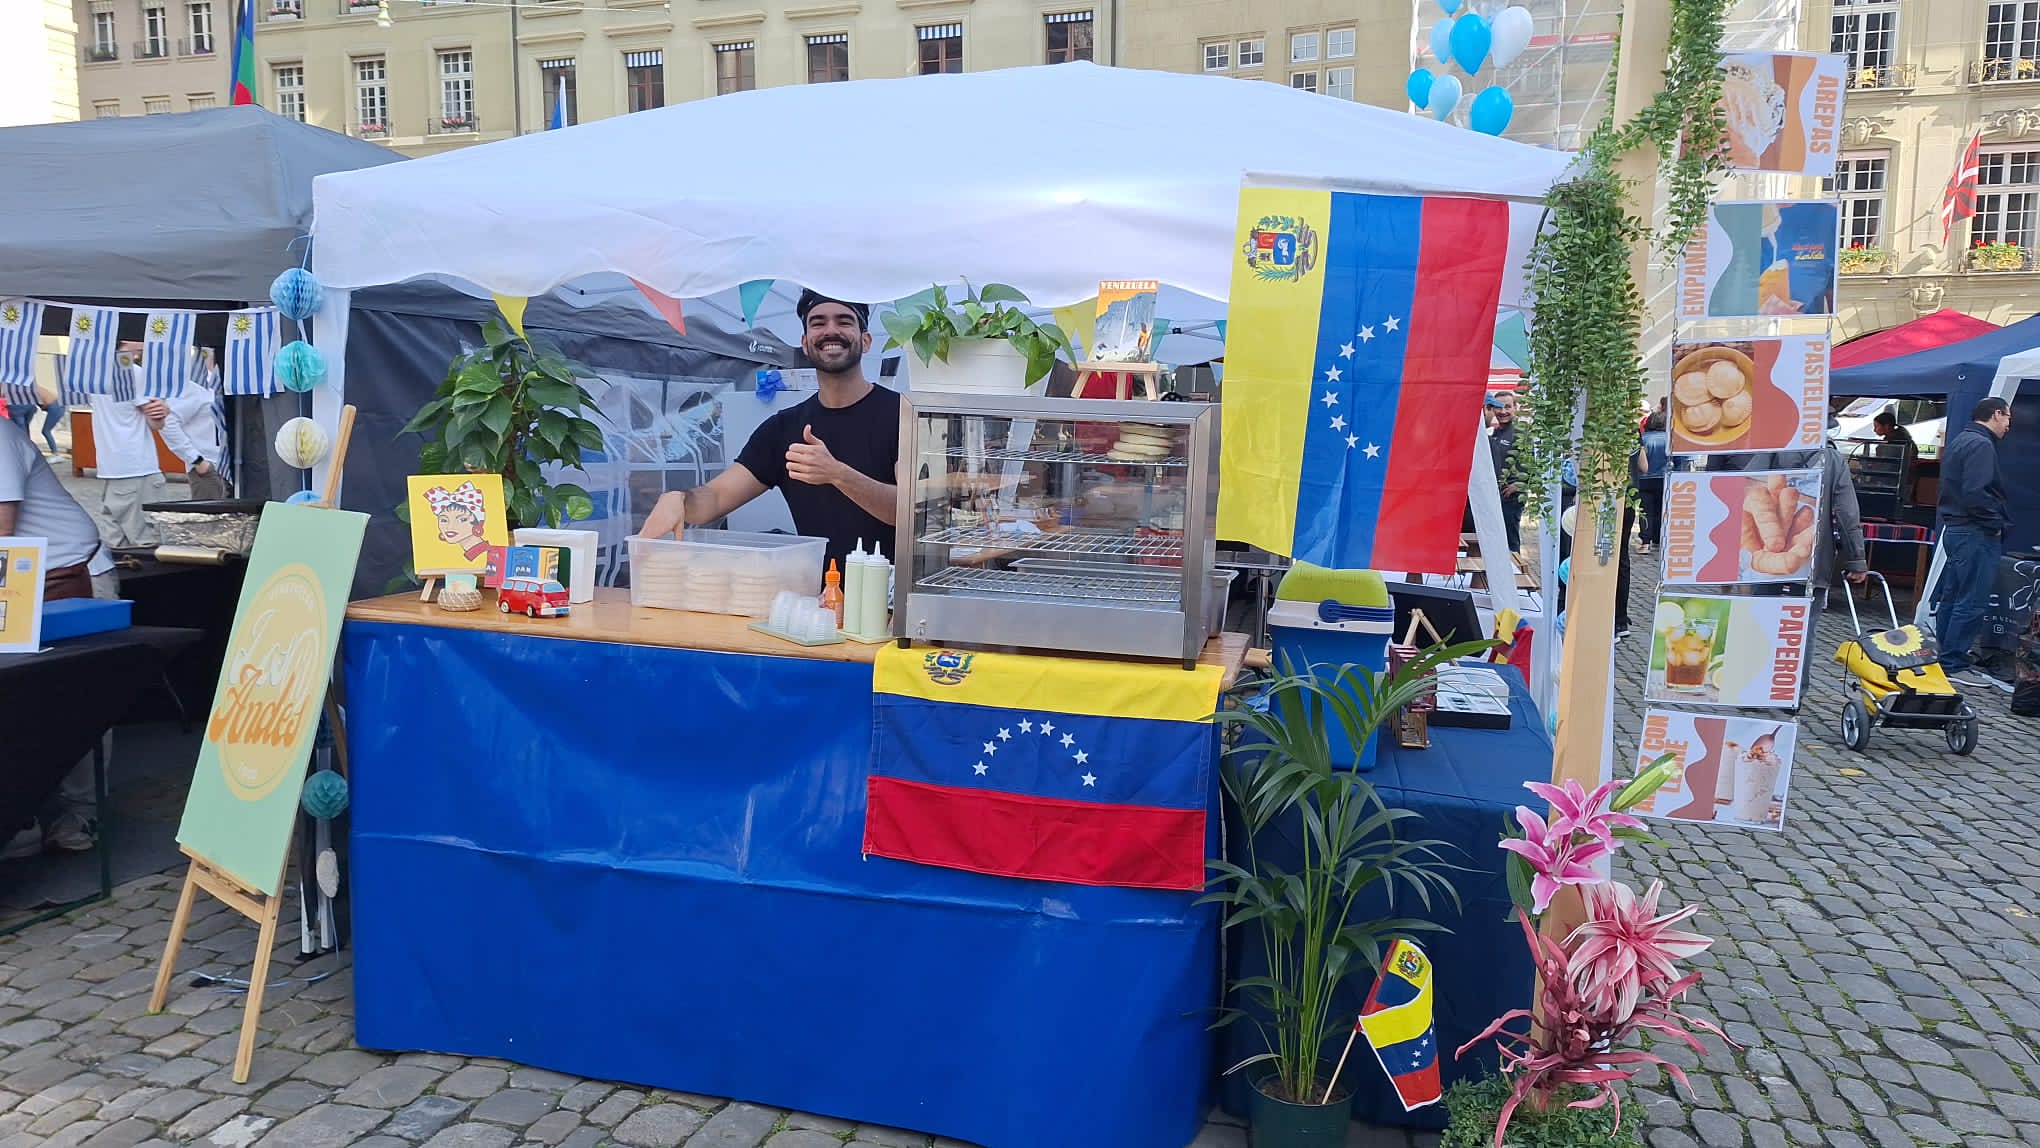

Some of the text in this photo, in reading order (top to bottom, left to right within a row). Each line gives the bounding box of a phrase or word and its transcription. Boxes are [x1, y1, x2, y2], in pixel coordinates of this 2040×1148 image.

[1809, 74, 1841, 154] AREPAS
[1101, 281, 1157, 290] VENEZUELA
[1801, 340, 1826, 445] PASTELITOS
[1770, 605, 1806, 701] PAPERON
[209, 664, 311, 748] Andes
[1643, 715, 1670, 751] CON
